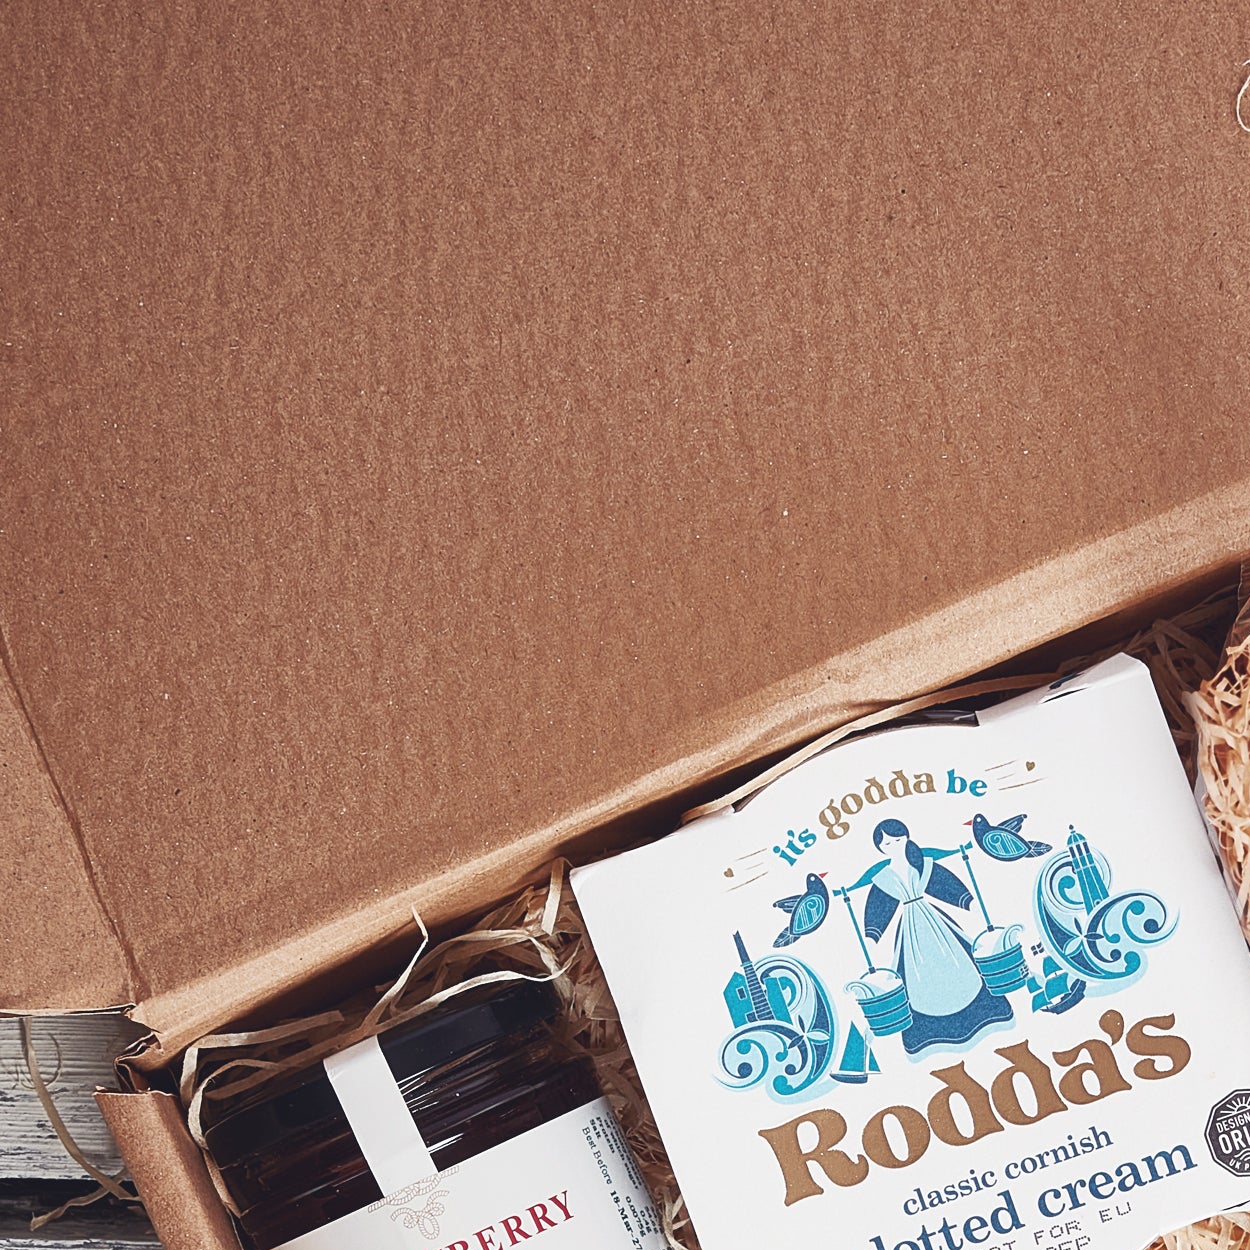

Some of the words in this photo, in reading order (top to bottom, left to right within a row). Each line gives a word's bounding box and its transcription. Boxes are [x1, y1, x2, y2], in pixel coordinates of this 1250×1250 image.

[773, 829, 816, 866] it's
[819, 770, 936, 840] godda
[947, 769, 989, 797] be
[759, 1009, 1191, 1207] Rodda's
[582, 1127, 596, 1149] Best
[593, 1150, 612, 1184] Before
[904, 1169, 997, 1215] classic
[1005, 1127, 1113, 1179] cornish
[1038, 1145, 1198, 1217] cream
[1229, 1159, 1241, 1169] UK
[1034, 1220, 1081, 1245] FOR
[1099, 1202, 1131, 1223] EU
